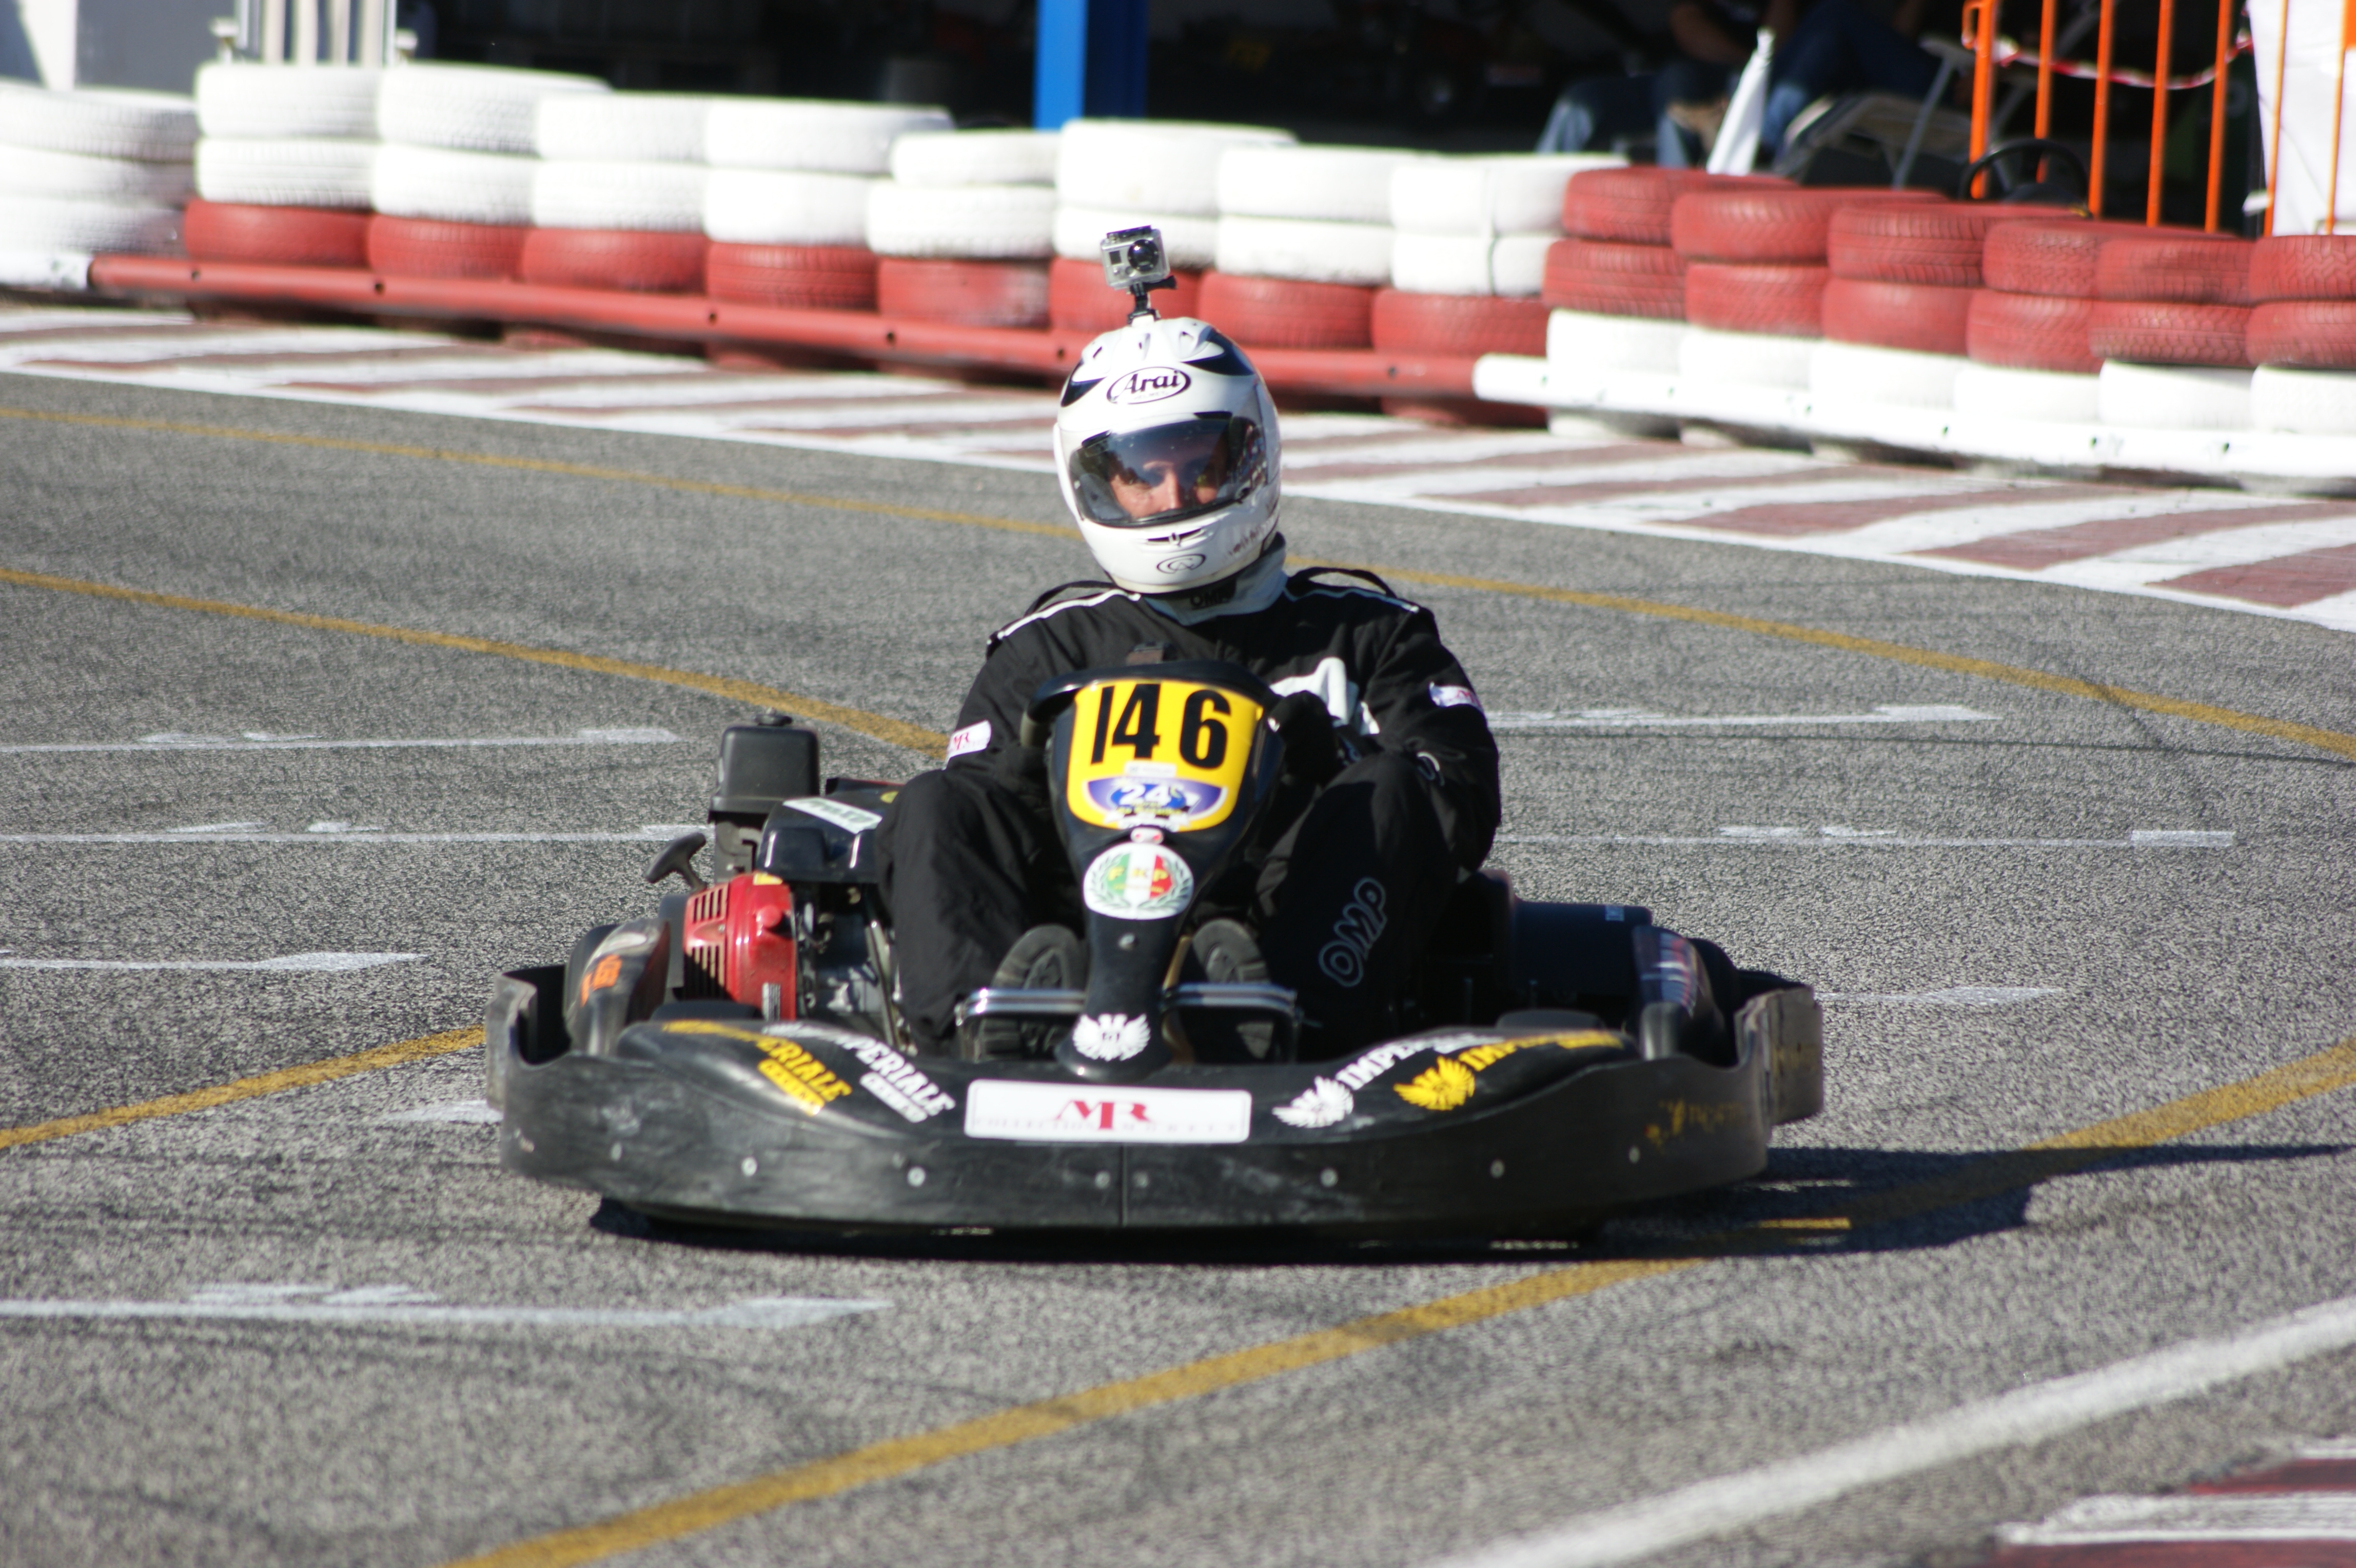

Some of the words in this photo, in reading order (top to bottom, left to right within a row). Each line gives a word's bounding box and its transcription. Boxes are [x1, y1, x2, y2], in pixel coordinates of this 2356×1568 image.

[1114, 369, 1181, 400] Arai
[1090, 683, 1231, 770] 146
[1319, 877, 1387, 987] OMP
[1056, 1100, 1151, 1130] MR
